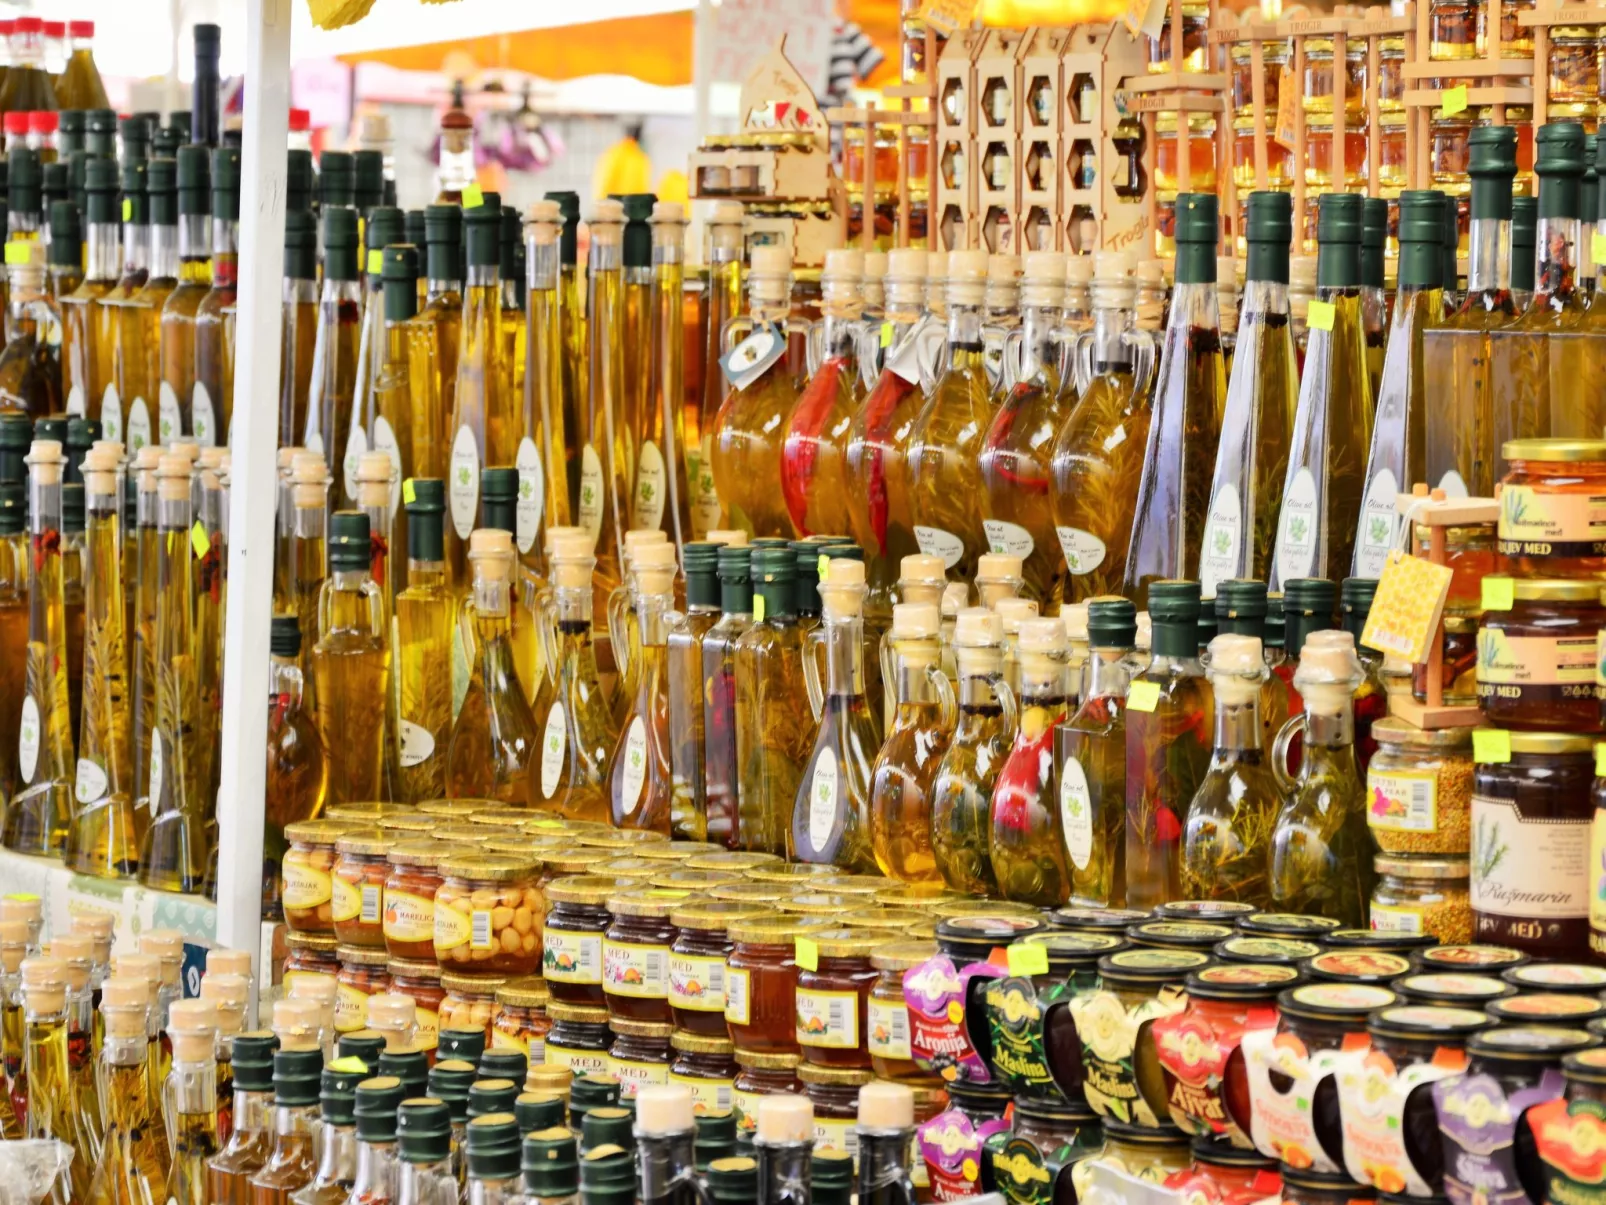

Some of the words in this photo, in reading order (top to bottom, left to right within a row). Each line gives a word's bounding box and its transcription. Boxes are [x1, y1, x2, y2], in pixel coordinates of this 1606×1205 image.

[1290, 20, 1322, 33] TROGIR
[1215, 28, 1240, 40] TROGIR
[1139, 97, 1166, 109] TROGIR
[1287, 498, 1302, 508] Olive
[1367, 498, 1384, 509] Olive
[1524, 542, 1552, 555] MED
[1496, 685, 1522, 698] MED
[1481, 880, 1573, 907] Ružmarin
[607, 948, 630, 960] MED
[671, 959, 693, 973] MED
[914, 1028, 968, 1057] Aronija
[570, 1057, 602, 1068] MED
[996, 1044, 1048, 1078] Maslina
[619, 1066, 648, 1079] MED
[1087, 1064, 1138, 1098] Maslina
[1171, 1081, 1226, 1119] Ajvar
